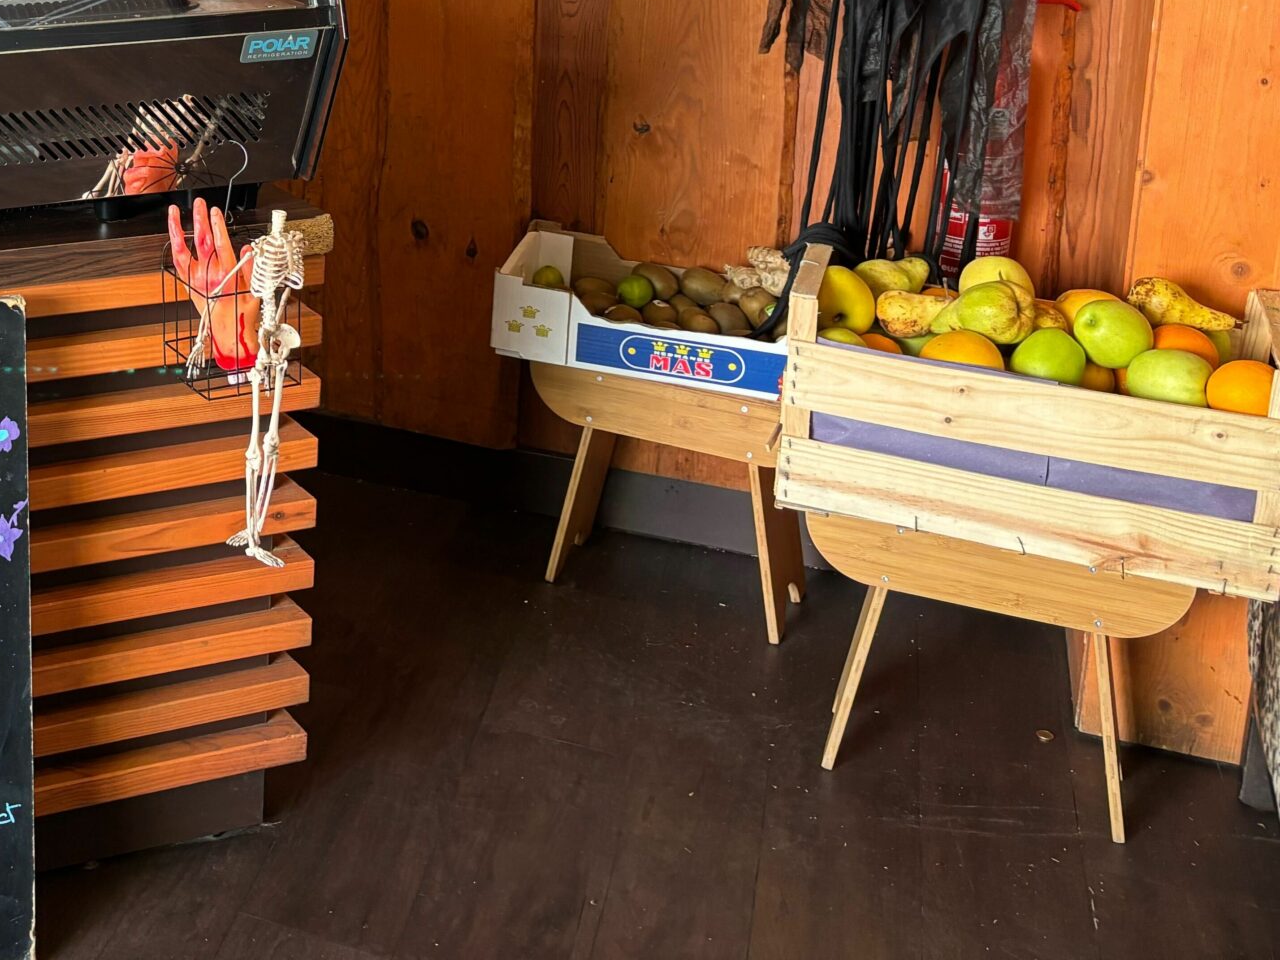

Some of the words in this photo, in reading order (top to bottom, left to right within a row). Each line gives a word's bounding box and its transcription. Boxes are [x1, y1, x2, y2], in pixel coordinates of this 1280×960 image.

[249, 34, 311, 54] POLAR
[247, 50, 308, 59] REFRIGERATION
[649, 354, 714, 379] MAS
